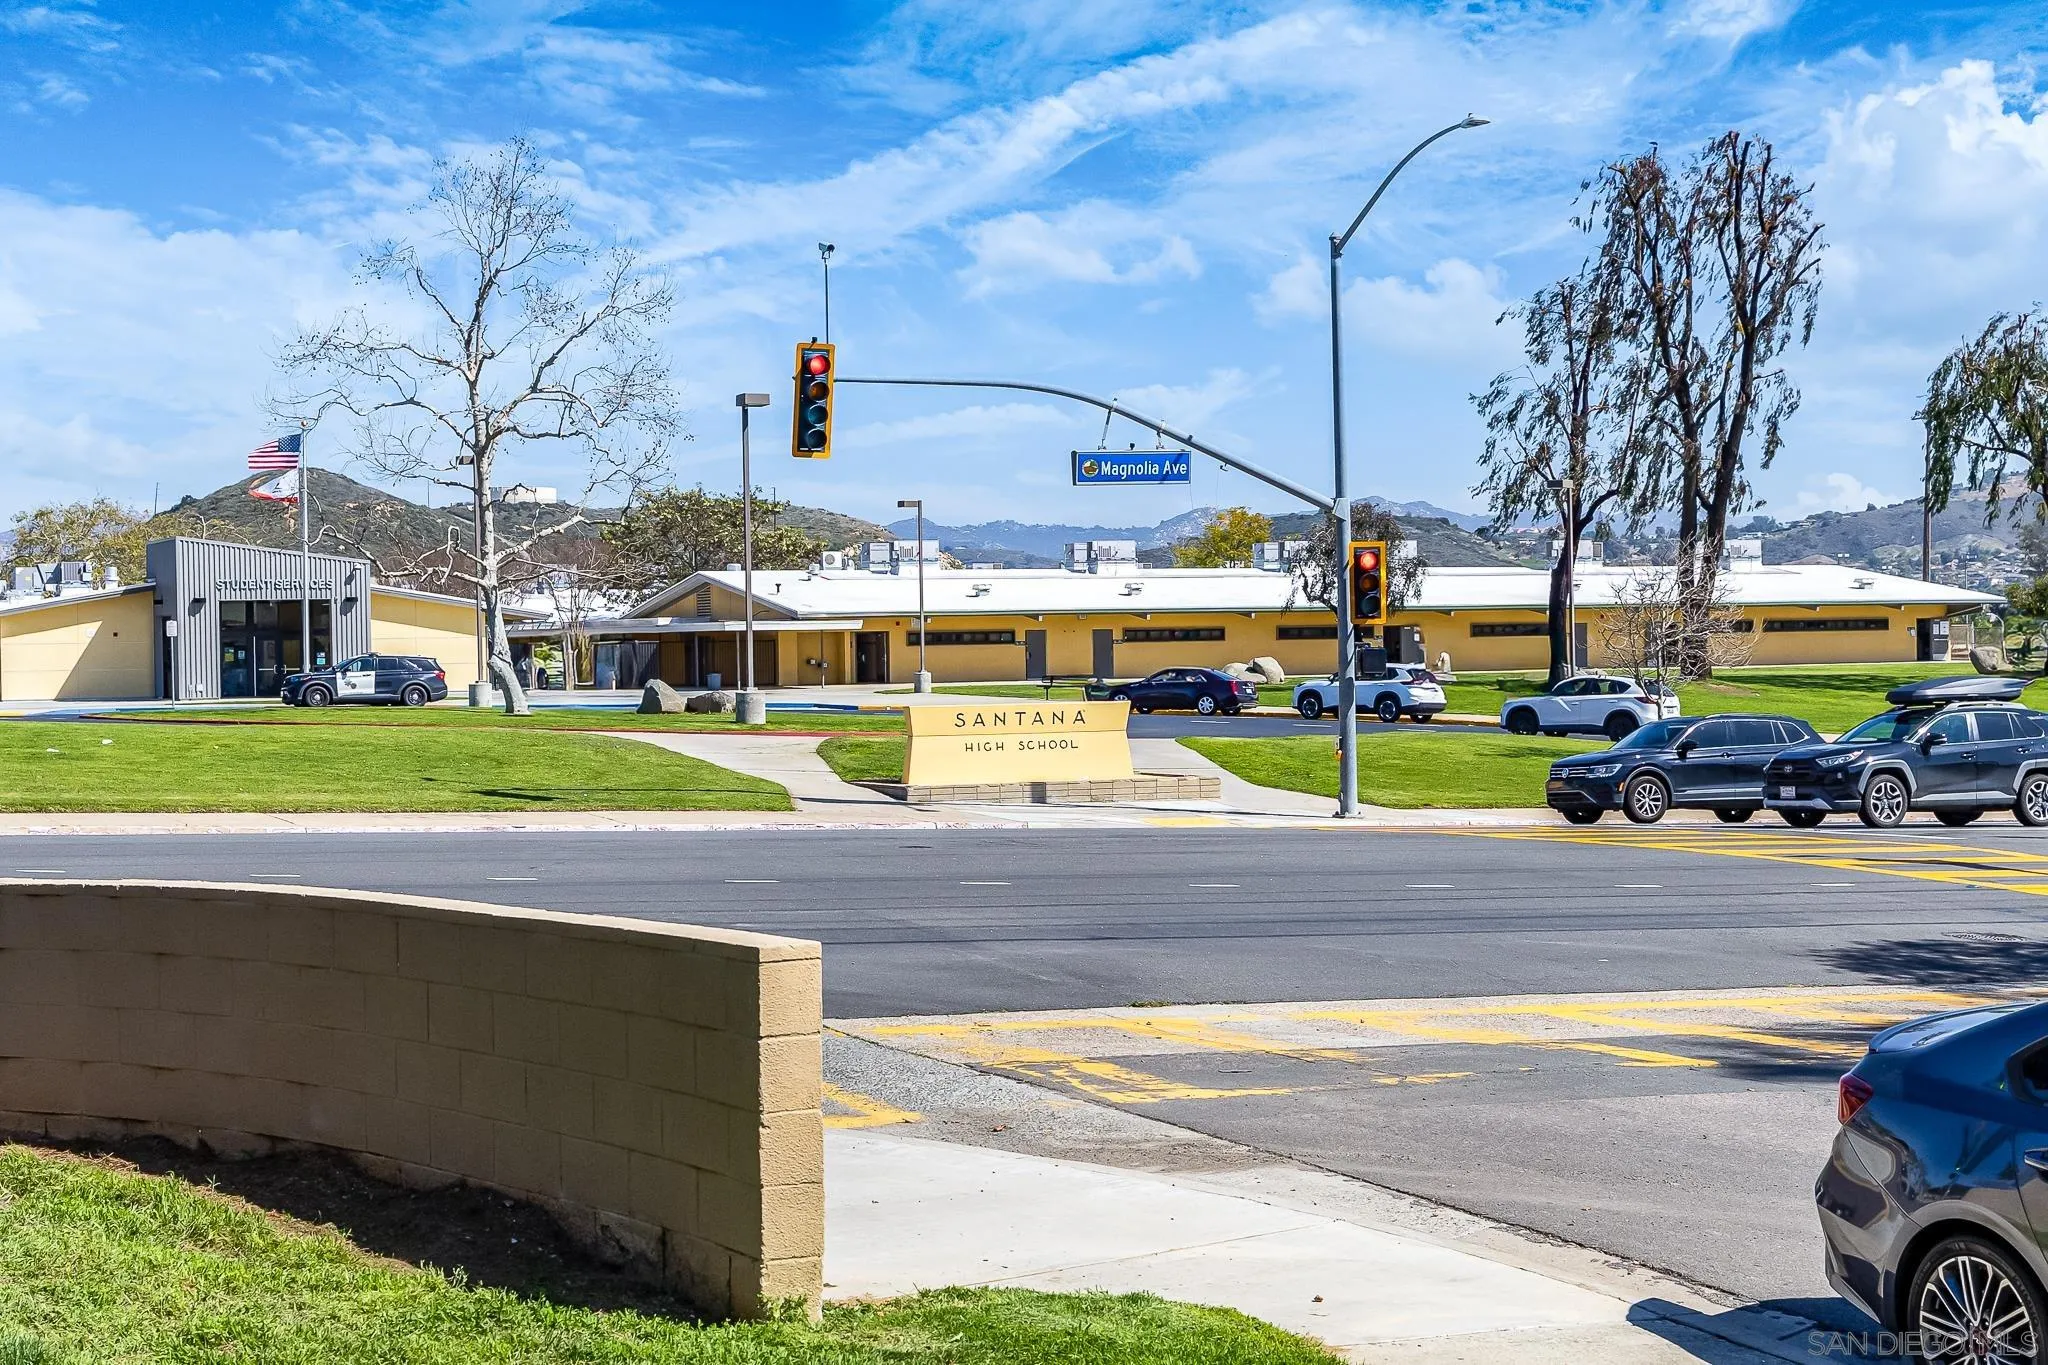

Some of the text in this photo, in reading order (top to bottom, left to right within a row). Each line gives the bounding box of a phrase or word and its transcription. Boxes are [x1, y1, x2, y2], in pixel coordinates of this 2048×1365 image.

[1101, 460, 1187, 480] Magnolia Ave
[215, 579, 272, 590] STUDENT
[954, 710, 1086, 728] SANTANA
[965, 739, 1079, 752] HIGH SCHOOL
